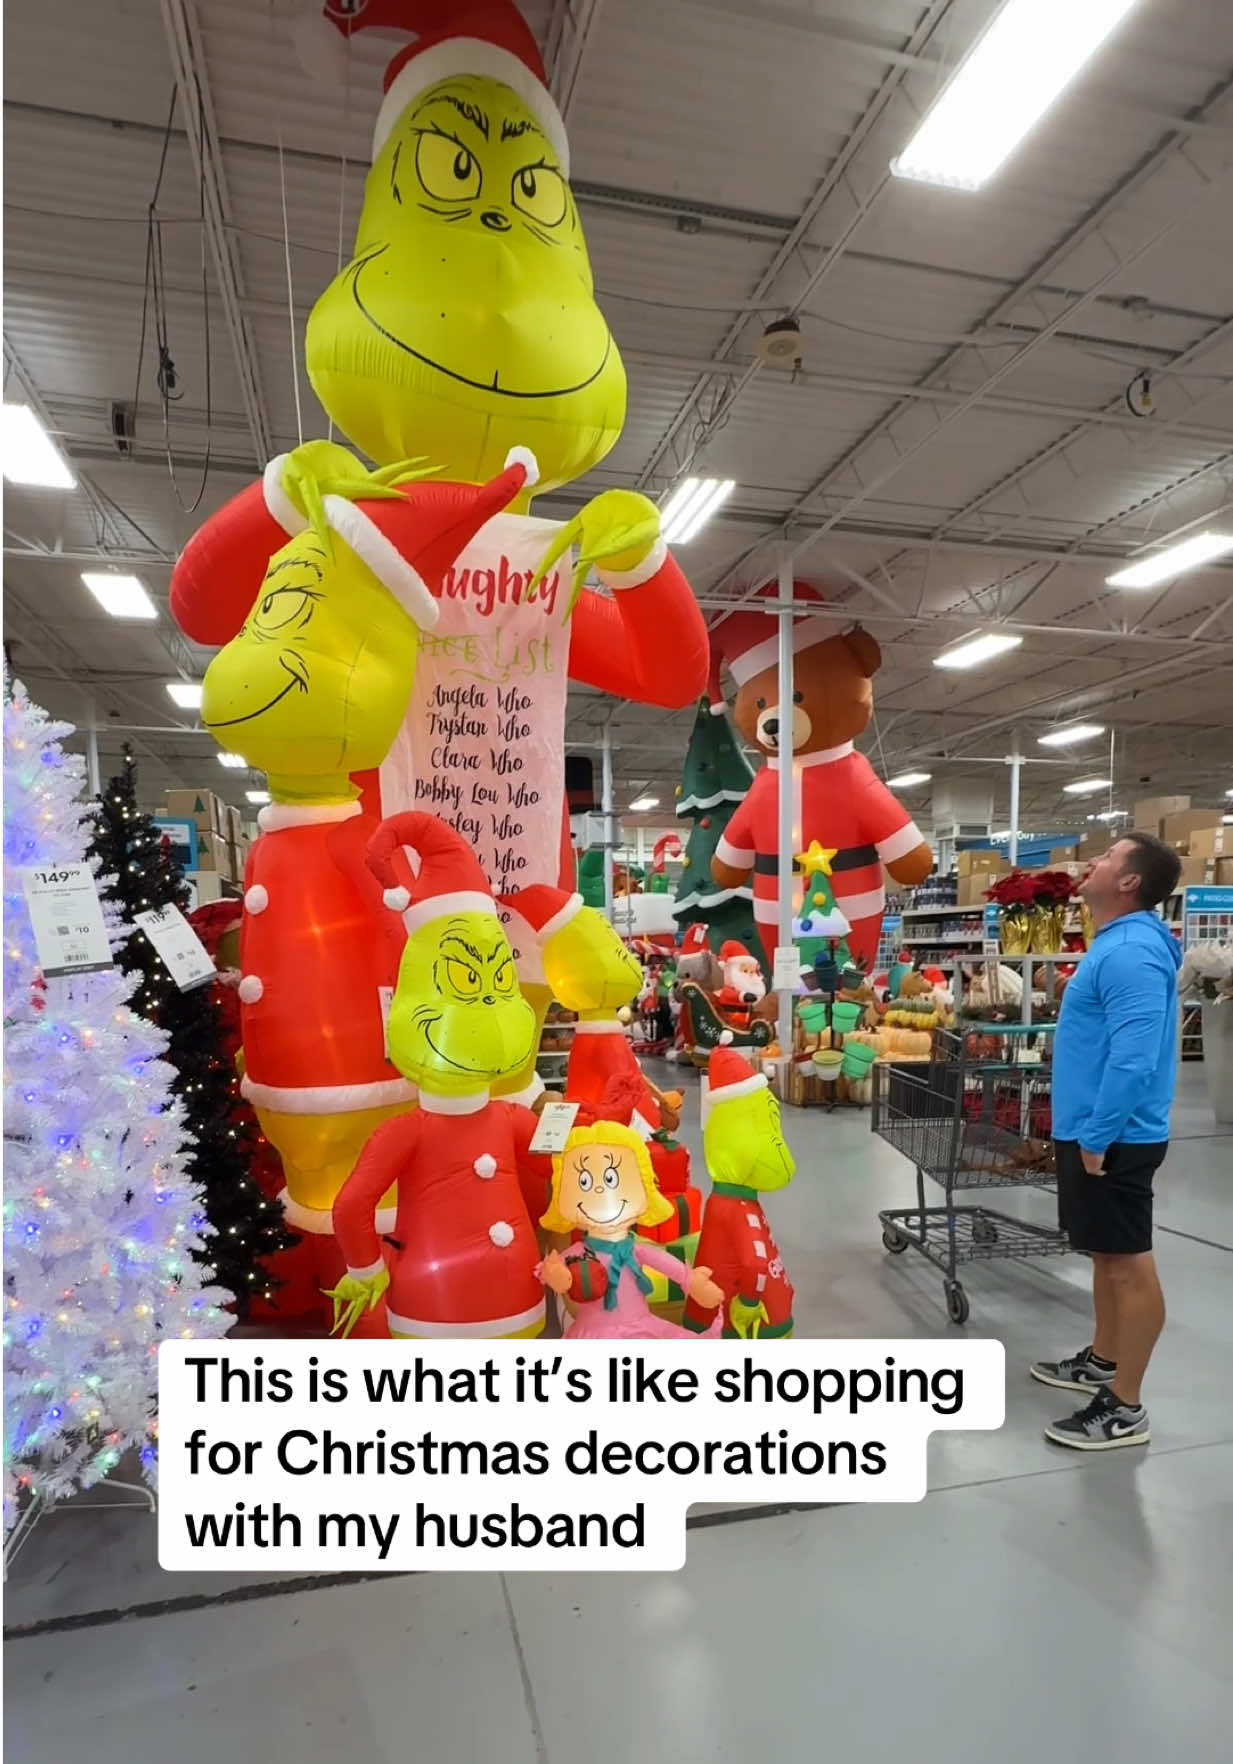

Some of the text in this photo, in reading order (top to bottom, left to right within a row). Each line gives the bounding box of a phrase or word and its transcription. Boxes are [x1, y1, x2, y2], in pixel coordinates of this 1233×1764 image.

[446, 554, 560, 617] ughty
[426, 684, 533, 717] Angela Who
[426, 711, 531, 744] Trystan Who
[431, 745, 523, 775] Clara Who
[415, 775, 540, 810] Bobby Lou Who
[491, 814, 524, 840] Who
[494, 848, 528, 873] Who
